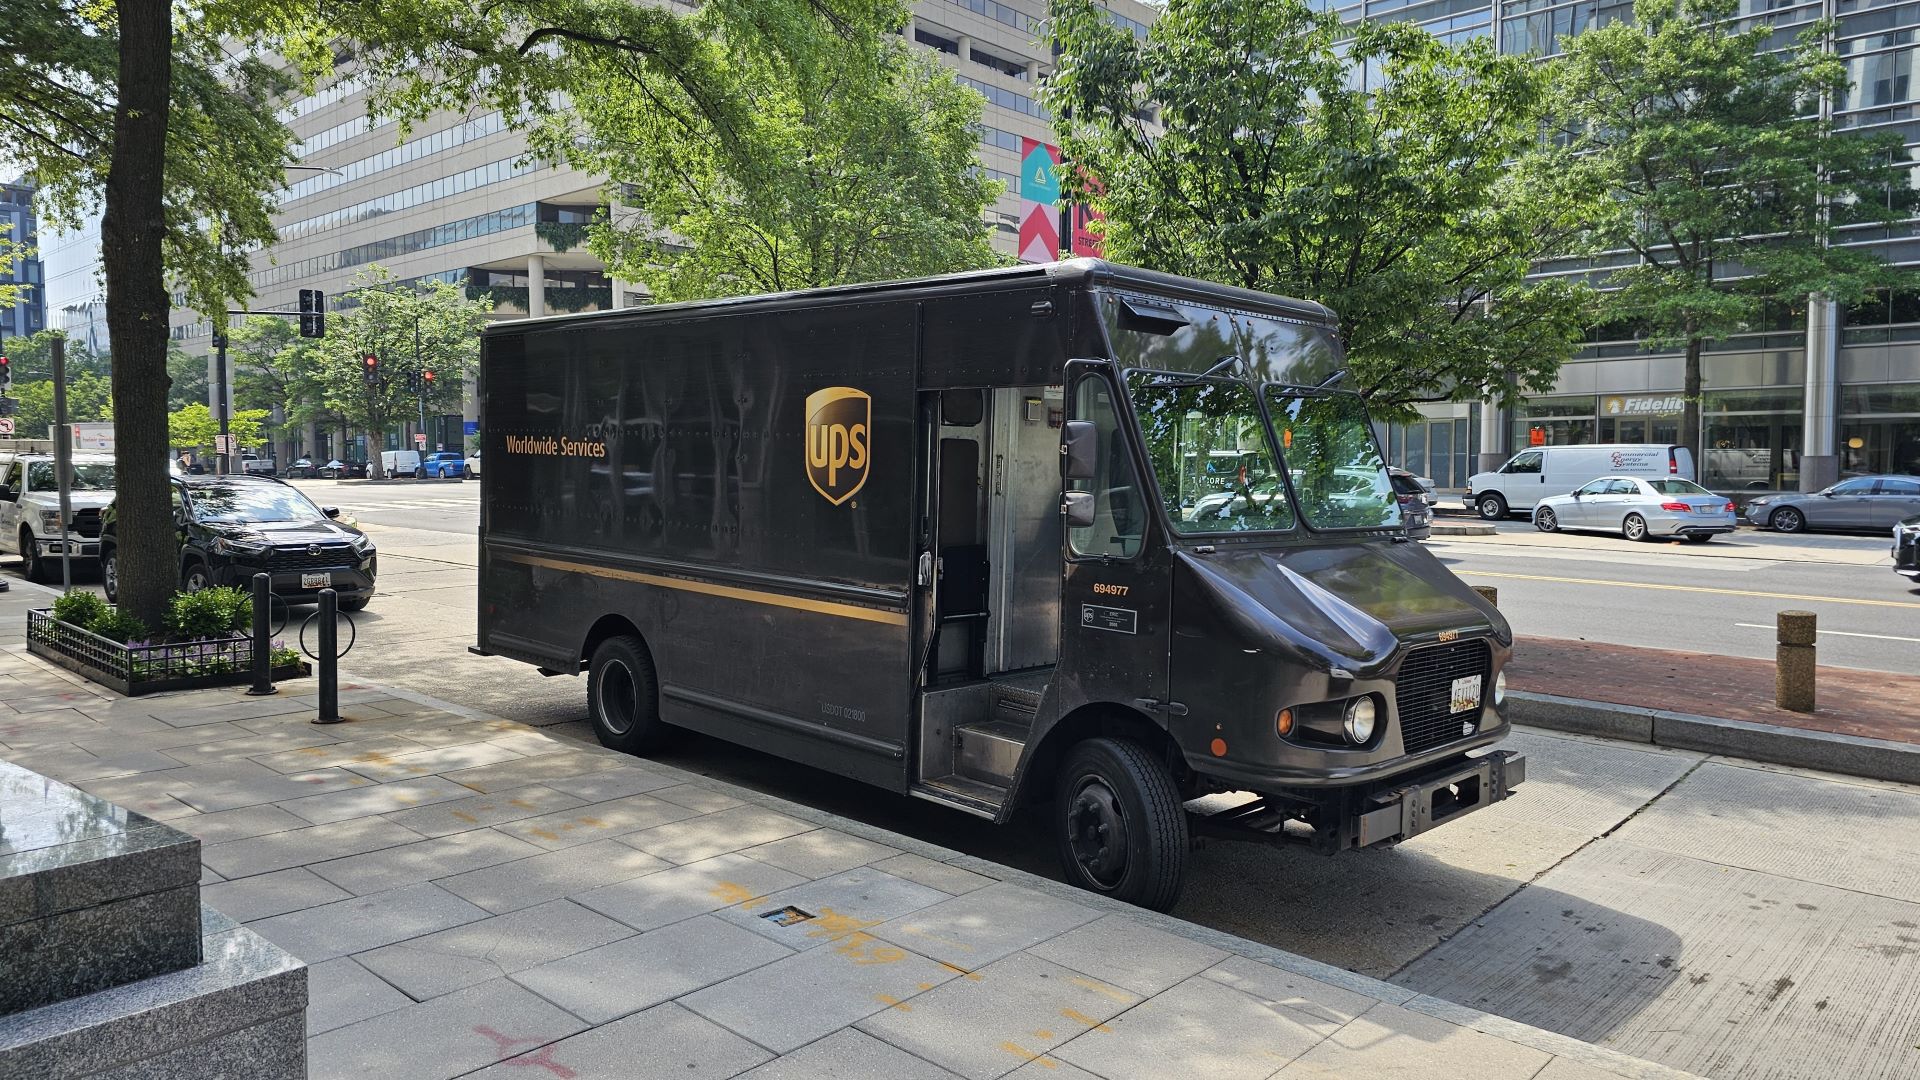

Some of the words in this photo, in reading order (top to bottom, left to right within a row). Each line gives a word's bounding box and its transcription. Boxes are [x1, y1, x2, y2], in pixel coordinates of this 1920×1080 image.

[506, 435, 553, 455] Worldwide
[560, 436, 605, 457] Services
[810, 423, 866, 487] ups
[1093, 583, 1129, 596] 694977
[1438, 629, 1459, 642] 694977
[821, 703, 843, 717] USDOT
